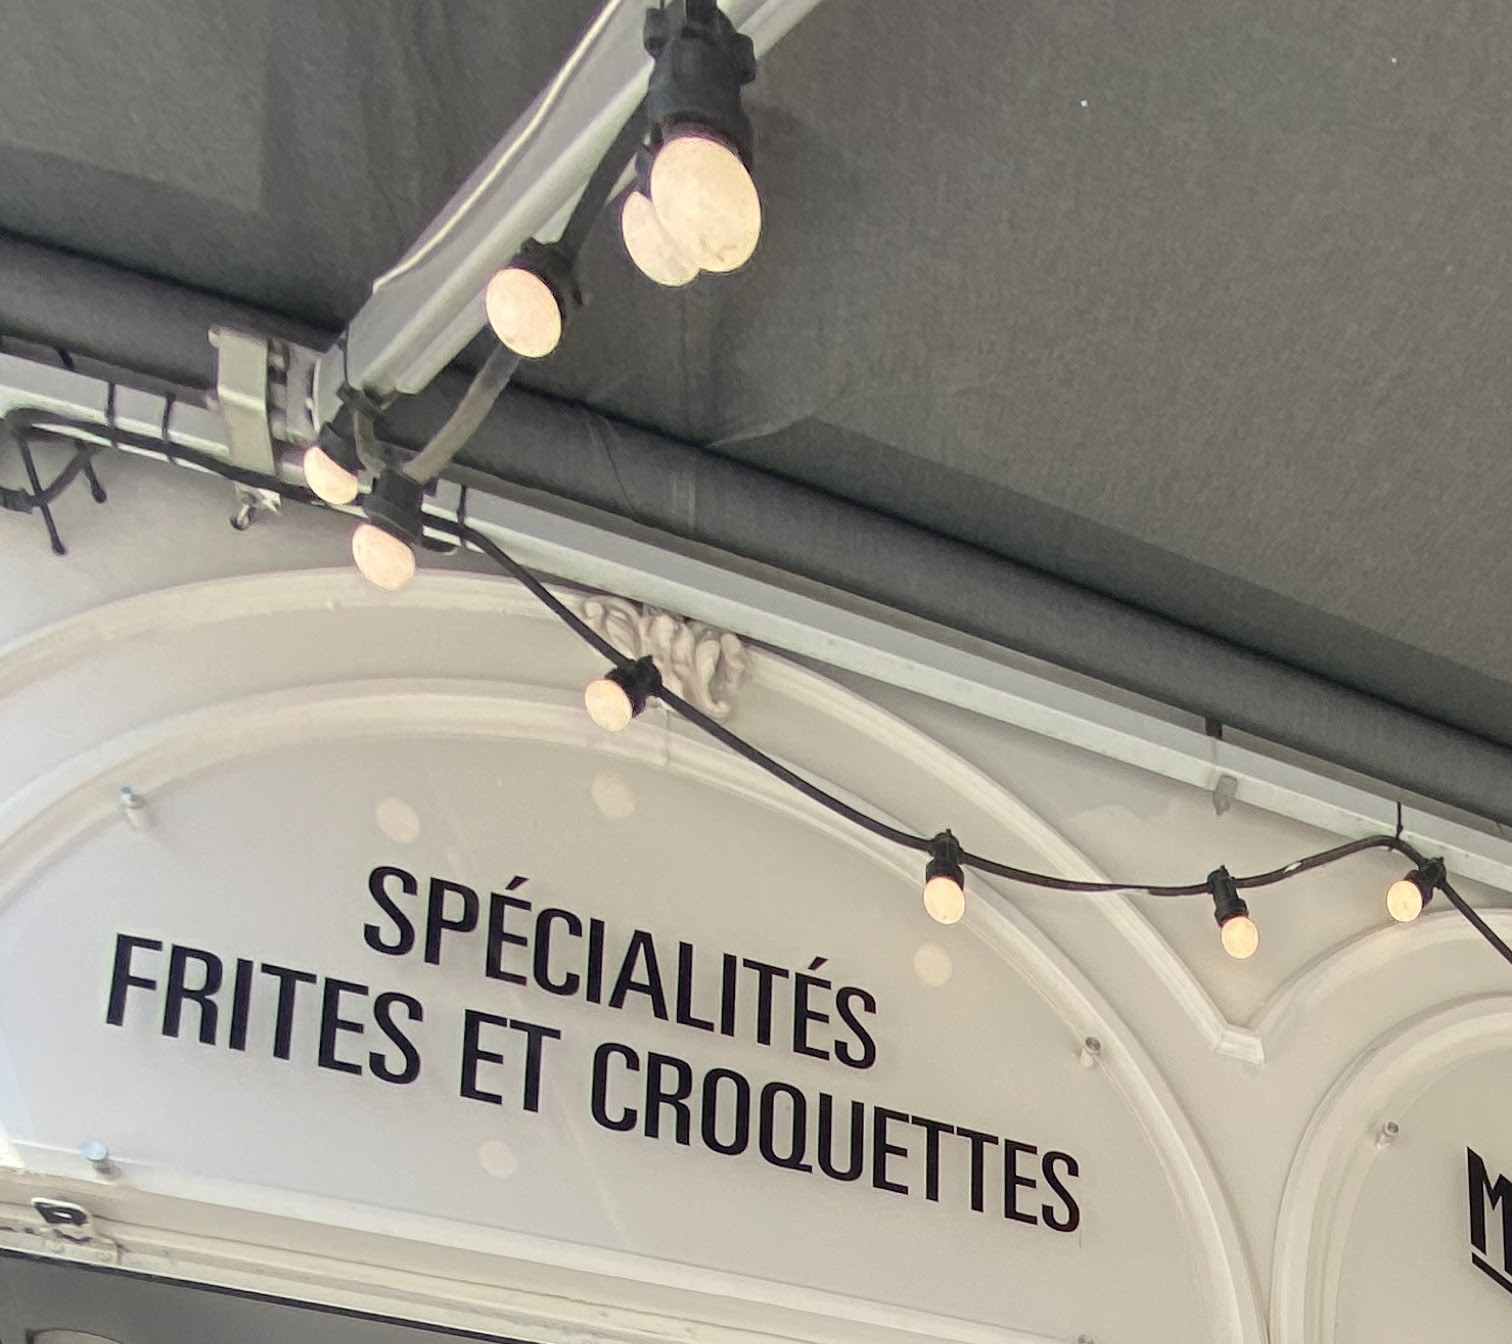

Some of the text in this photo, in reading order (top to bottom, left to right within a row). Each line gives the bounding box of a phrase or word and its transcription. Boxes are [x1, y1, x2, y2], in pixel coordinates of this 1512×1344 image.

[106, 933, 1082, 1233] FRITES ET CROQUETTES
[364, 866, 878, 1069] SPÉCIALITÉS
